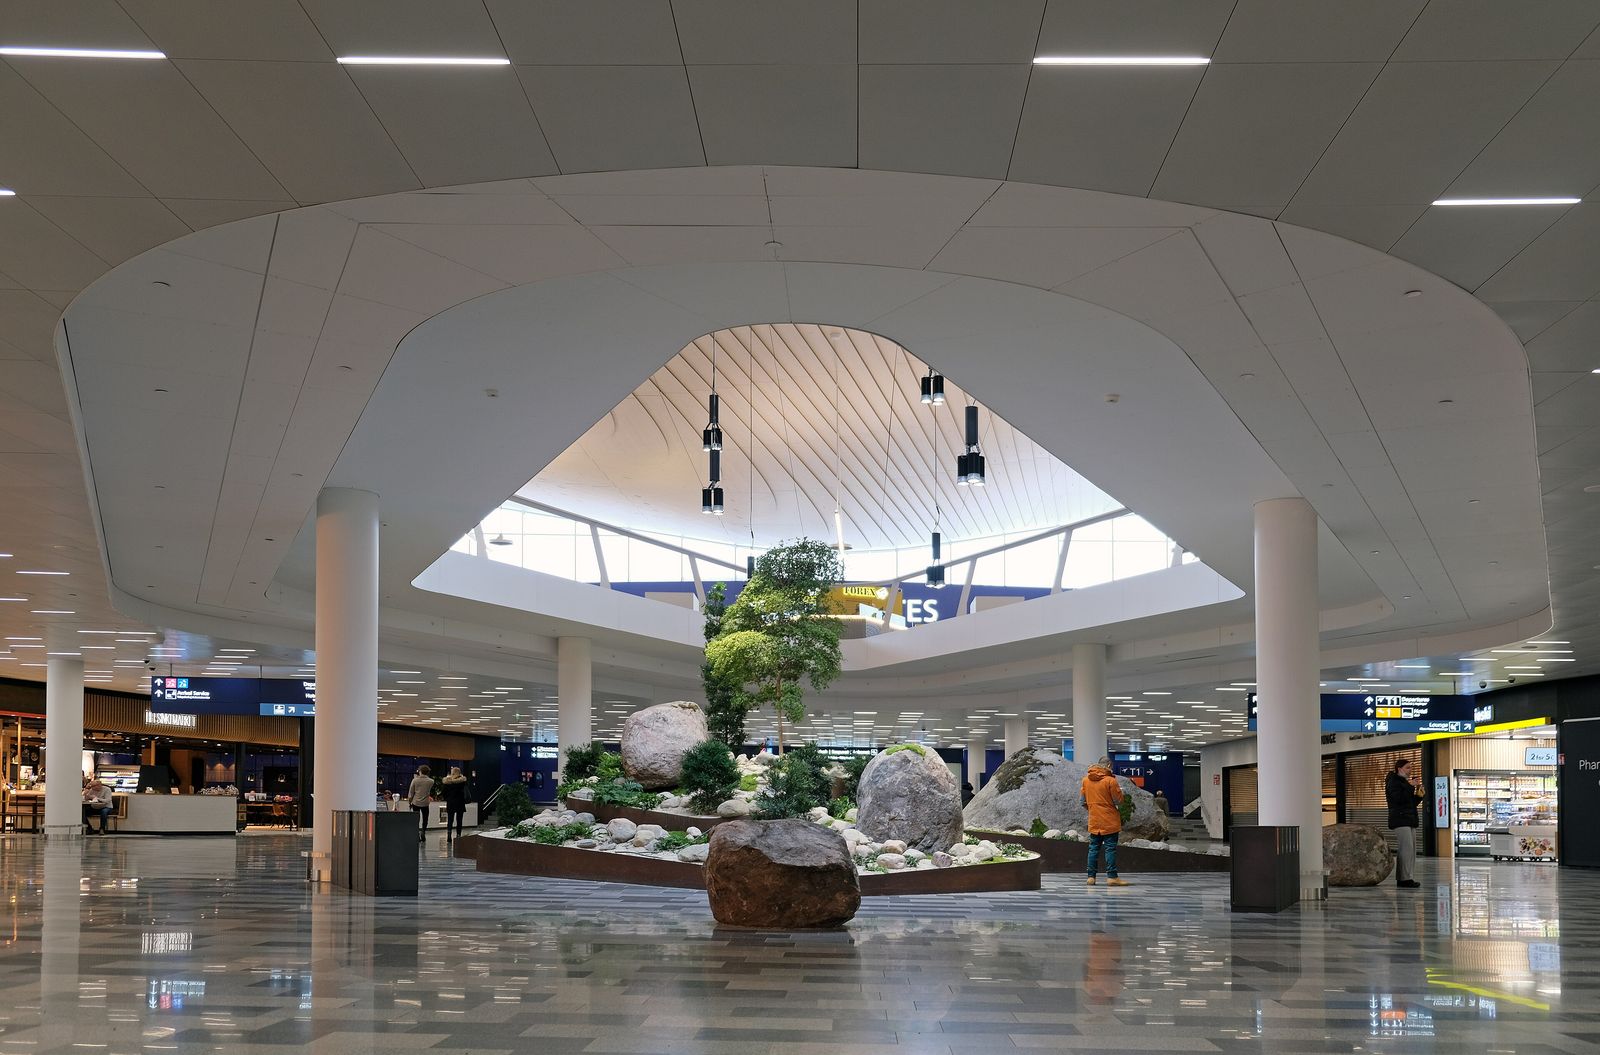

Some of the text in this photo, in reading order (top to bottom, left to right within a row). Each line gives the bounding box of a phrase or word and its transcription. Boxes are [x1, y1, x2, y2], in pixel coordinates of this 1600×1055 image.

[844, 586, 876, 597] FOREX
[903, 599, 939, 623] ES
[1579, 759, 1600, 771] Phar
[1130, 767, 1140, 776] T1
